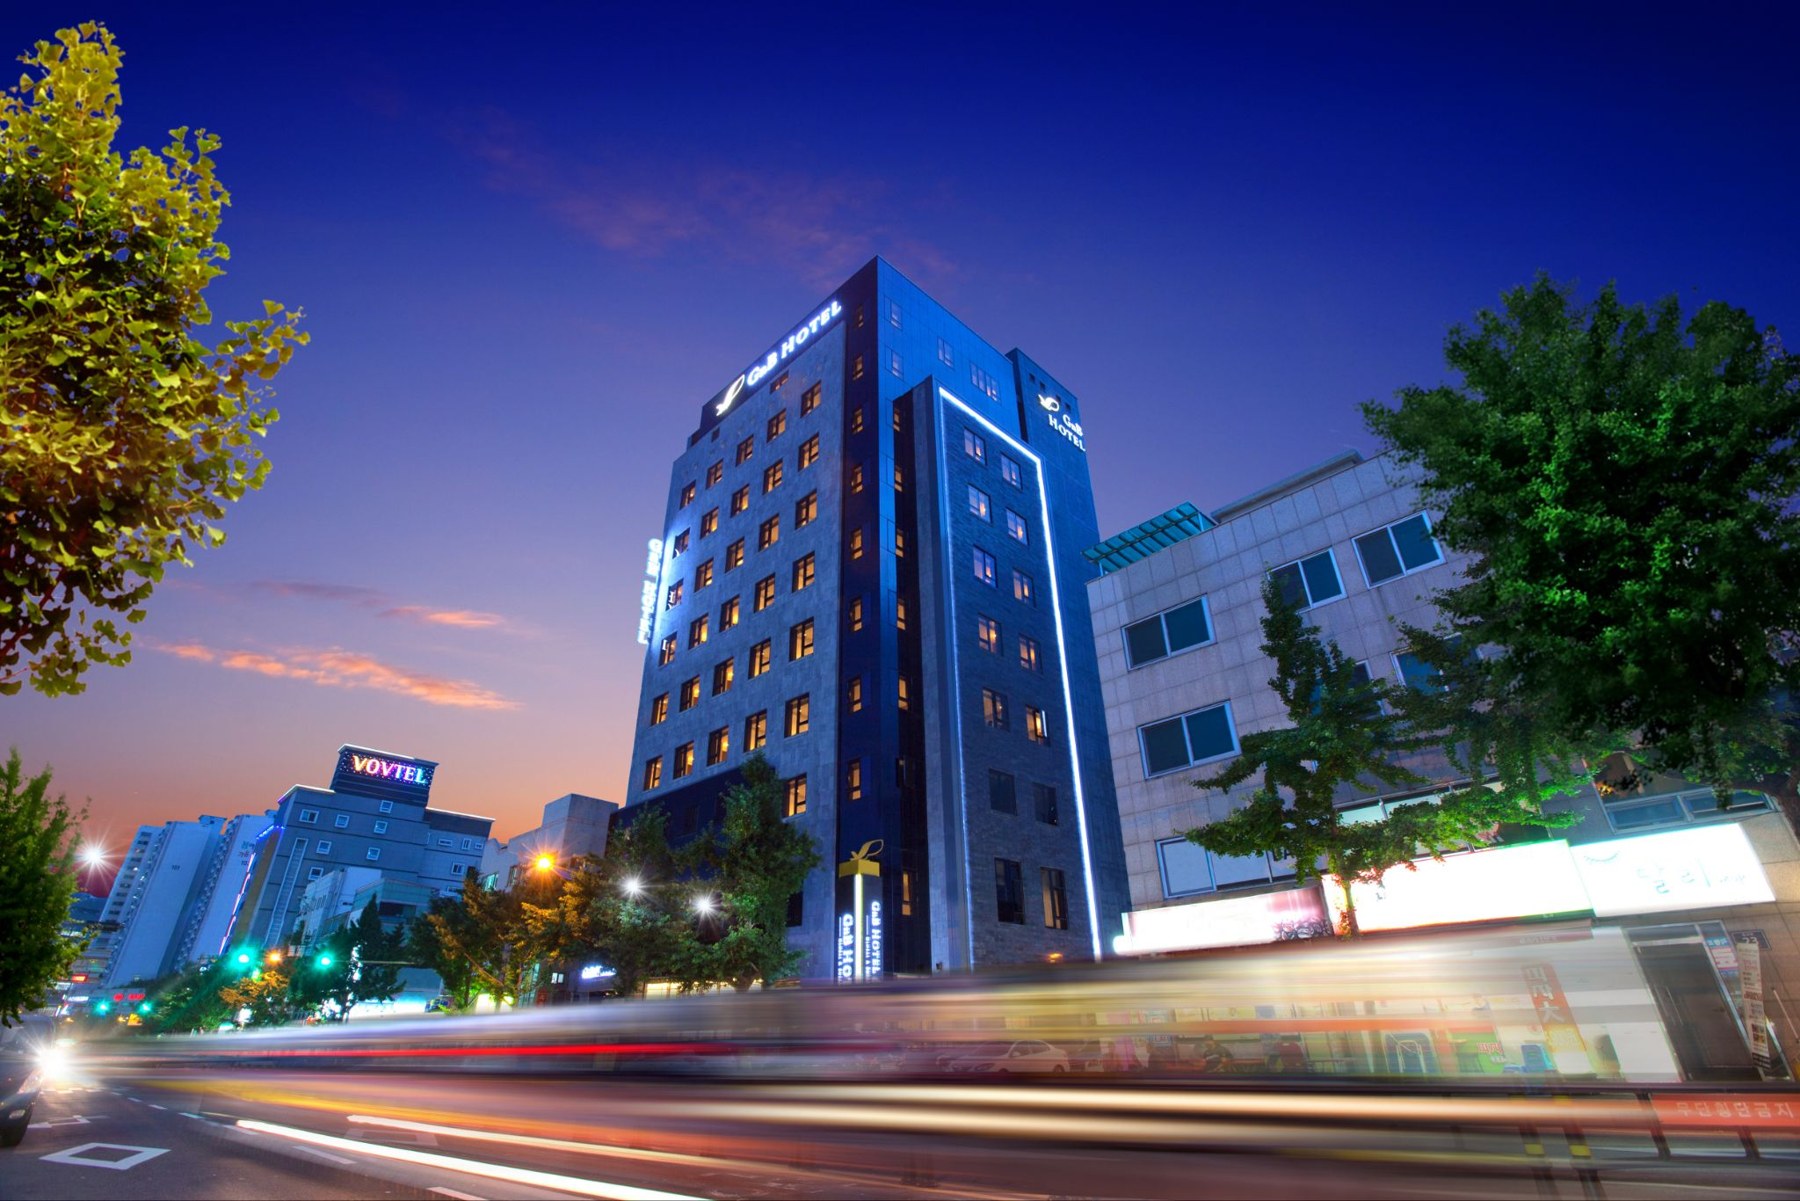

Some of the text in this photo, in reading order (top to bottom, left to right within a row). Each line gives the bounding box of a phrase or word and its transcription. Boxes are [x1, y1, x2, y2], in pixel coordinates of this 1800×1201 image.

[781, 301, 842, 359] HOTEL
[1048, 414, 1086, 452] HOTEL
[871, 928, 881, 974] HOTEL
